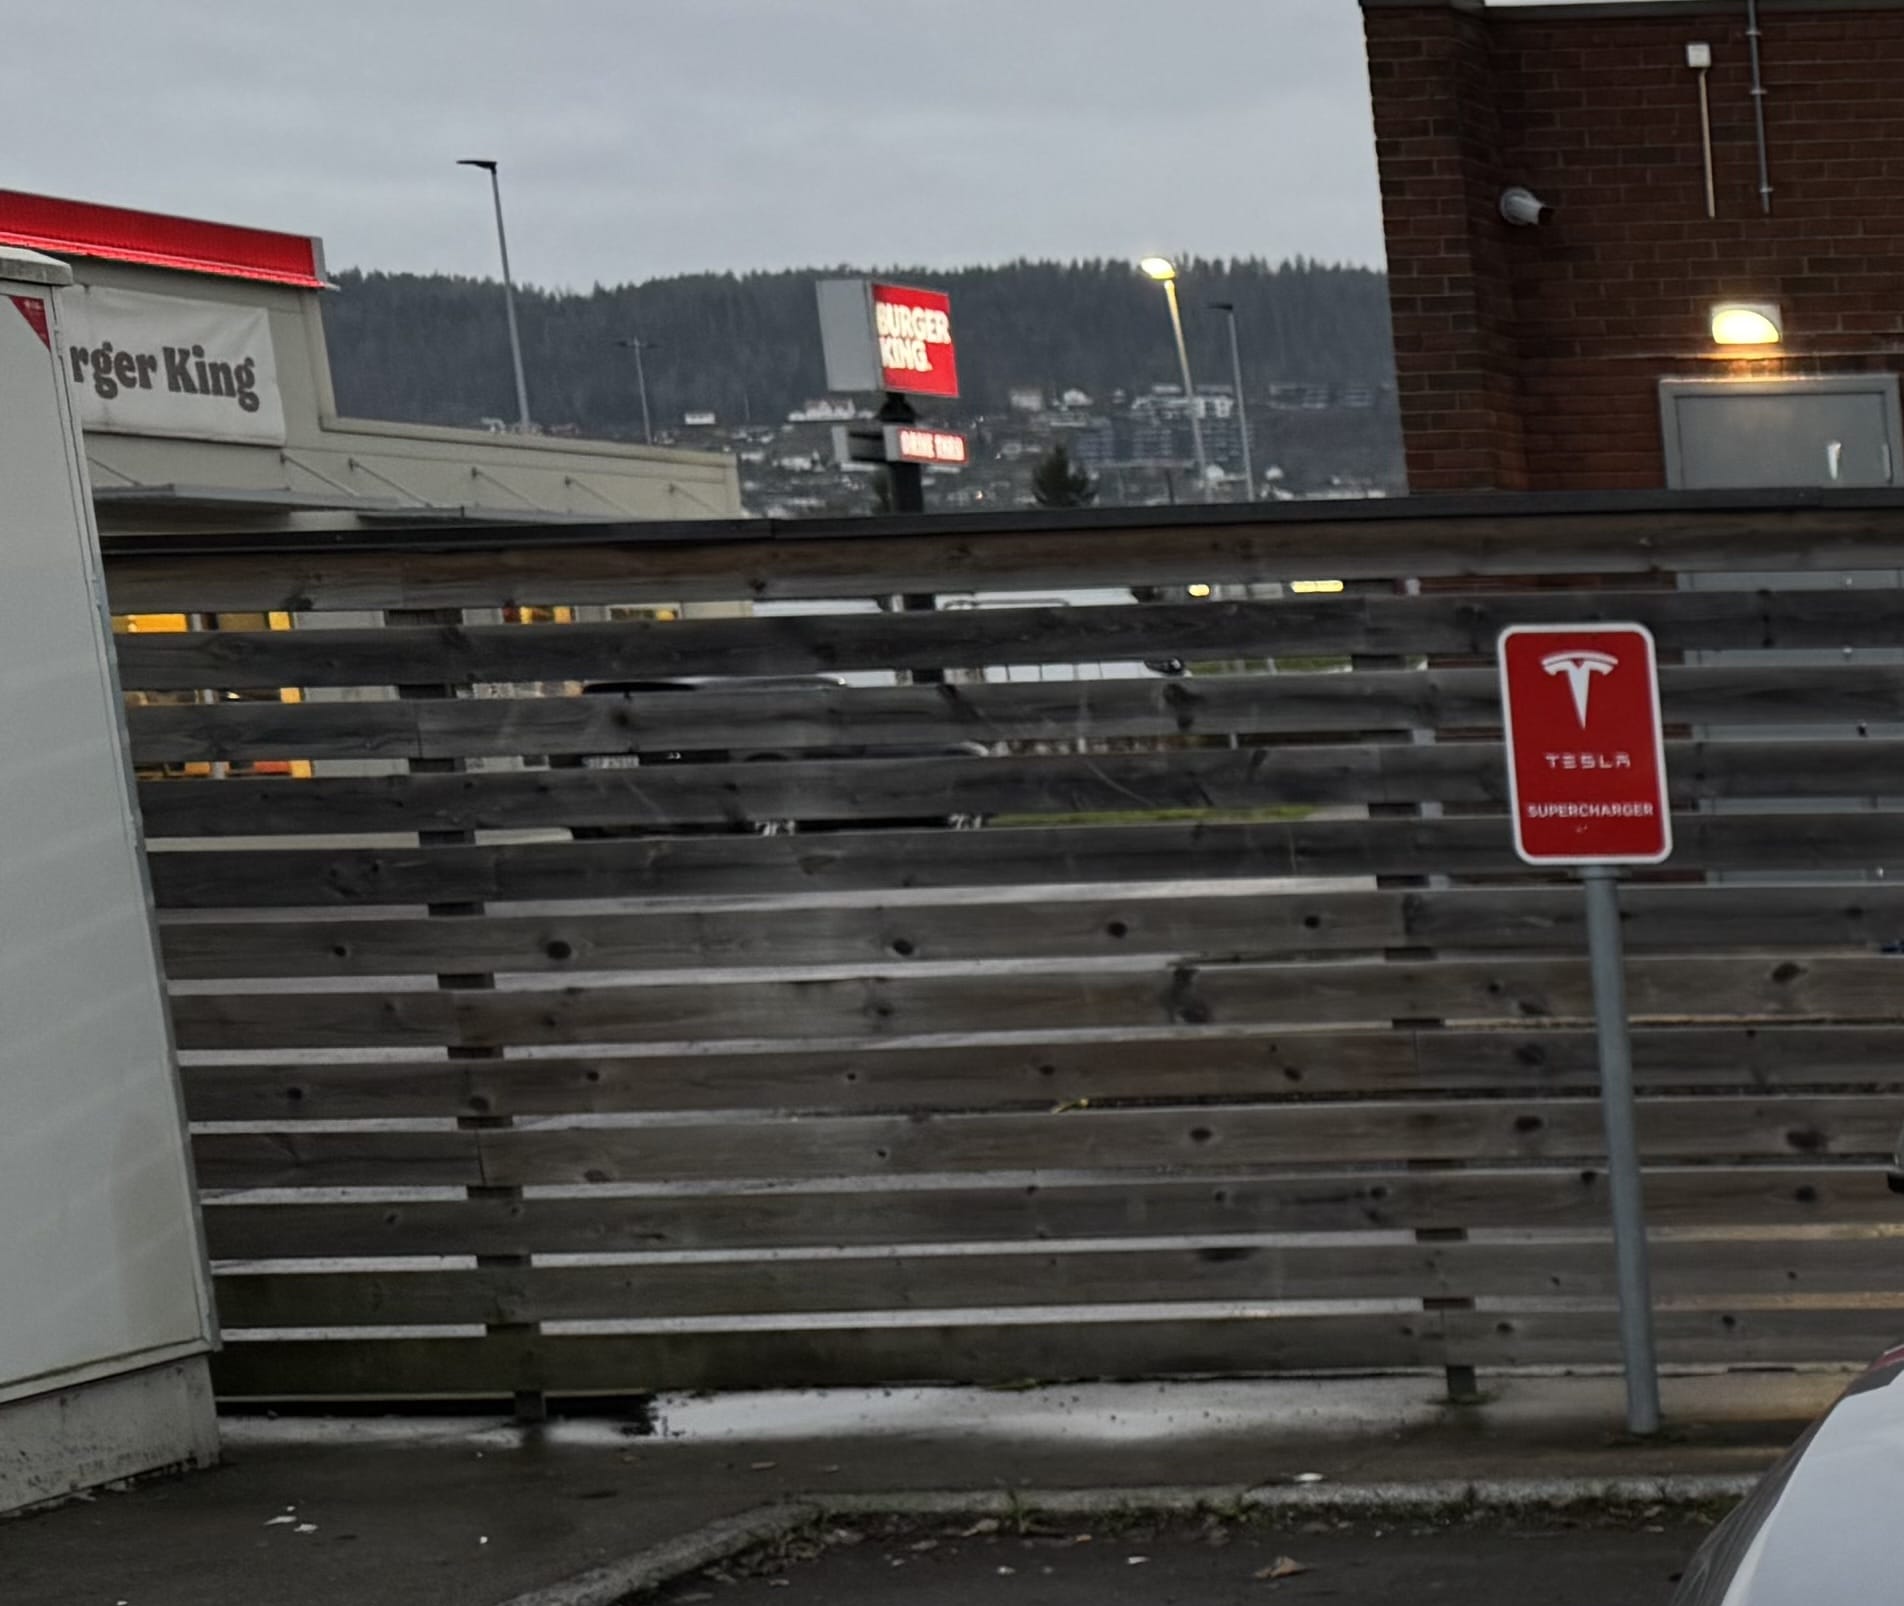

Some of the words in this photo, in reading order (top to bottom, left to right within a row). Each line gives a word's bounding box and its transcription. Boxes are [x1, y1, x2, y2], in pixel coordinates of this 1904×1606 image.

[876, 303, 951, 344] BURGER
[70, 342, 157, 399] rger
[163, 345, 259, 412] King
[1546, 753, 1631, 769] TESLA
[1527, 803, 1654, 818] SUPERCHARGER
